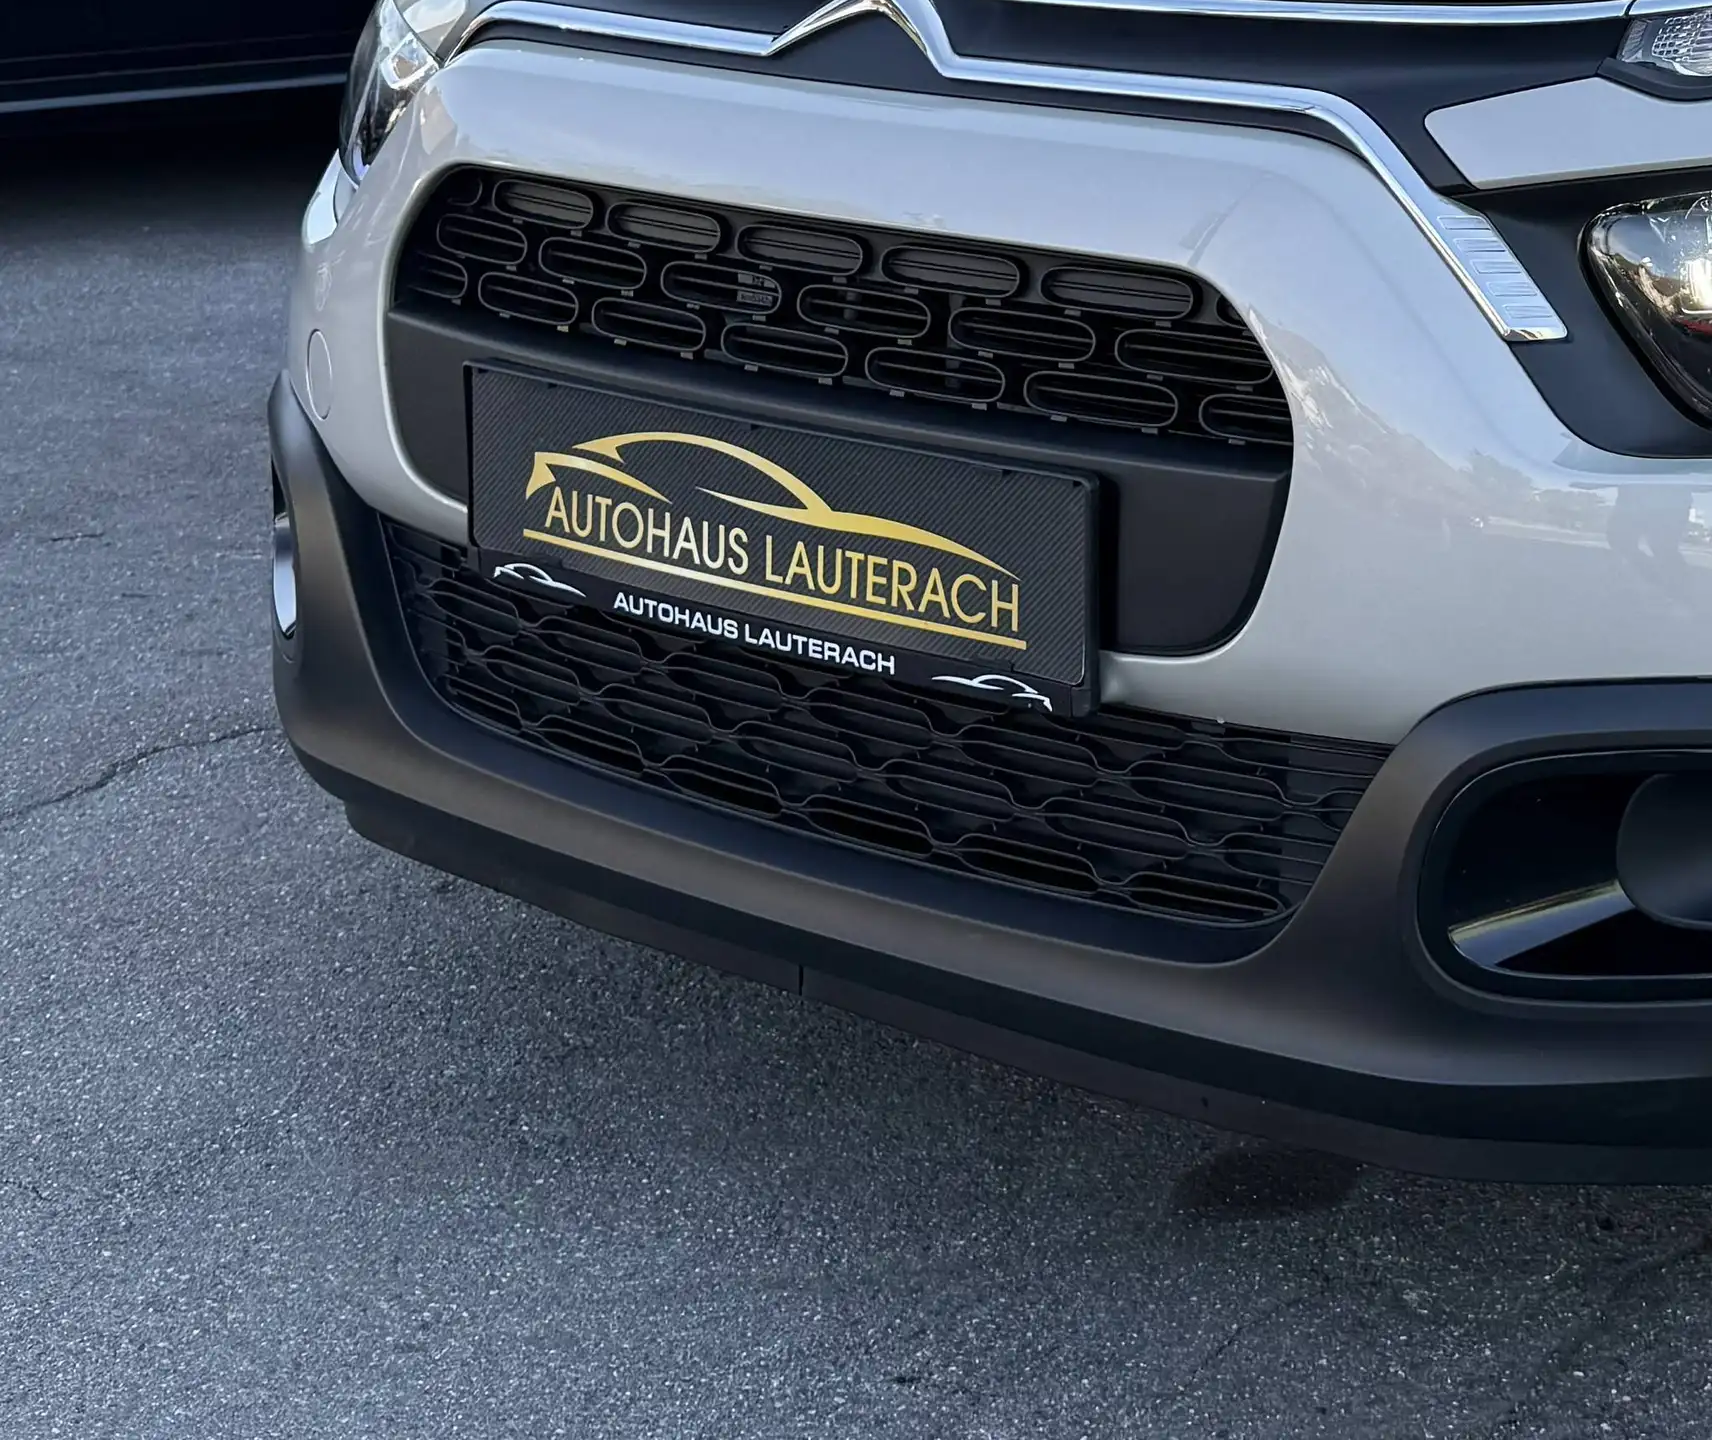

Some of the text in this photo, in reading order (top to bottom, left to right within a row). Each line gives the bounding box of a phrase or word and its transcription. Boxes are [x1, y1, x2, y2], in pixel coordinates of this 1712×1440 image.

[544, 486, 1019, 633] AUTOHAUS LAUTERACH
[613, 591, 896, 675] AUTOHAUS LAUTERACH
